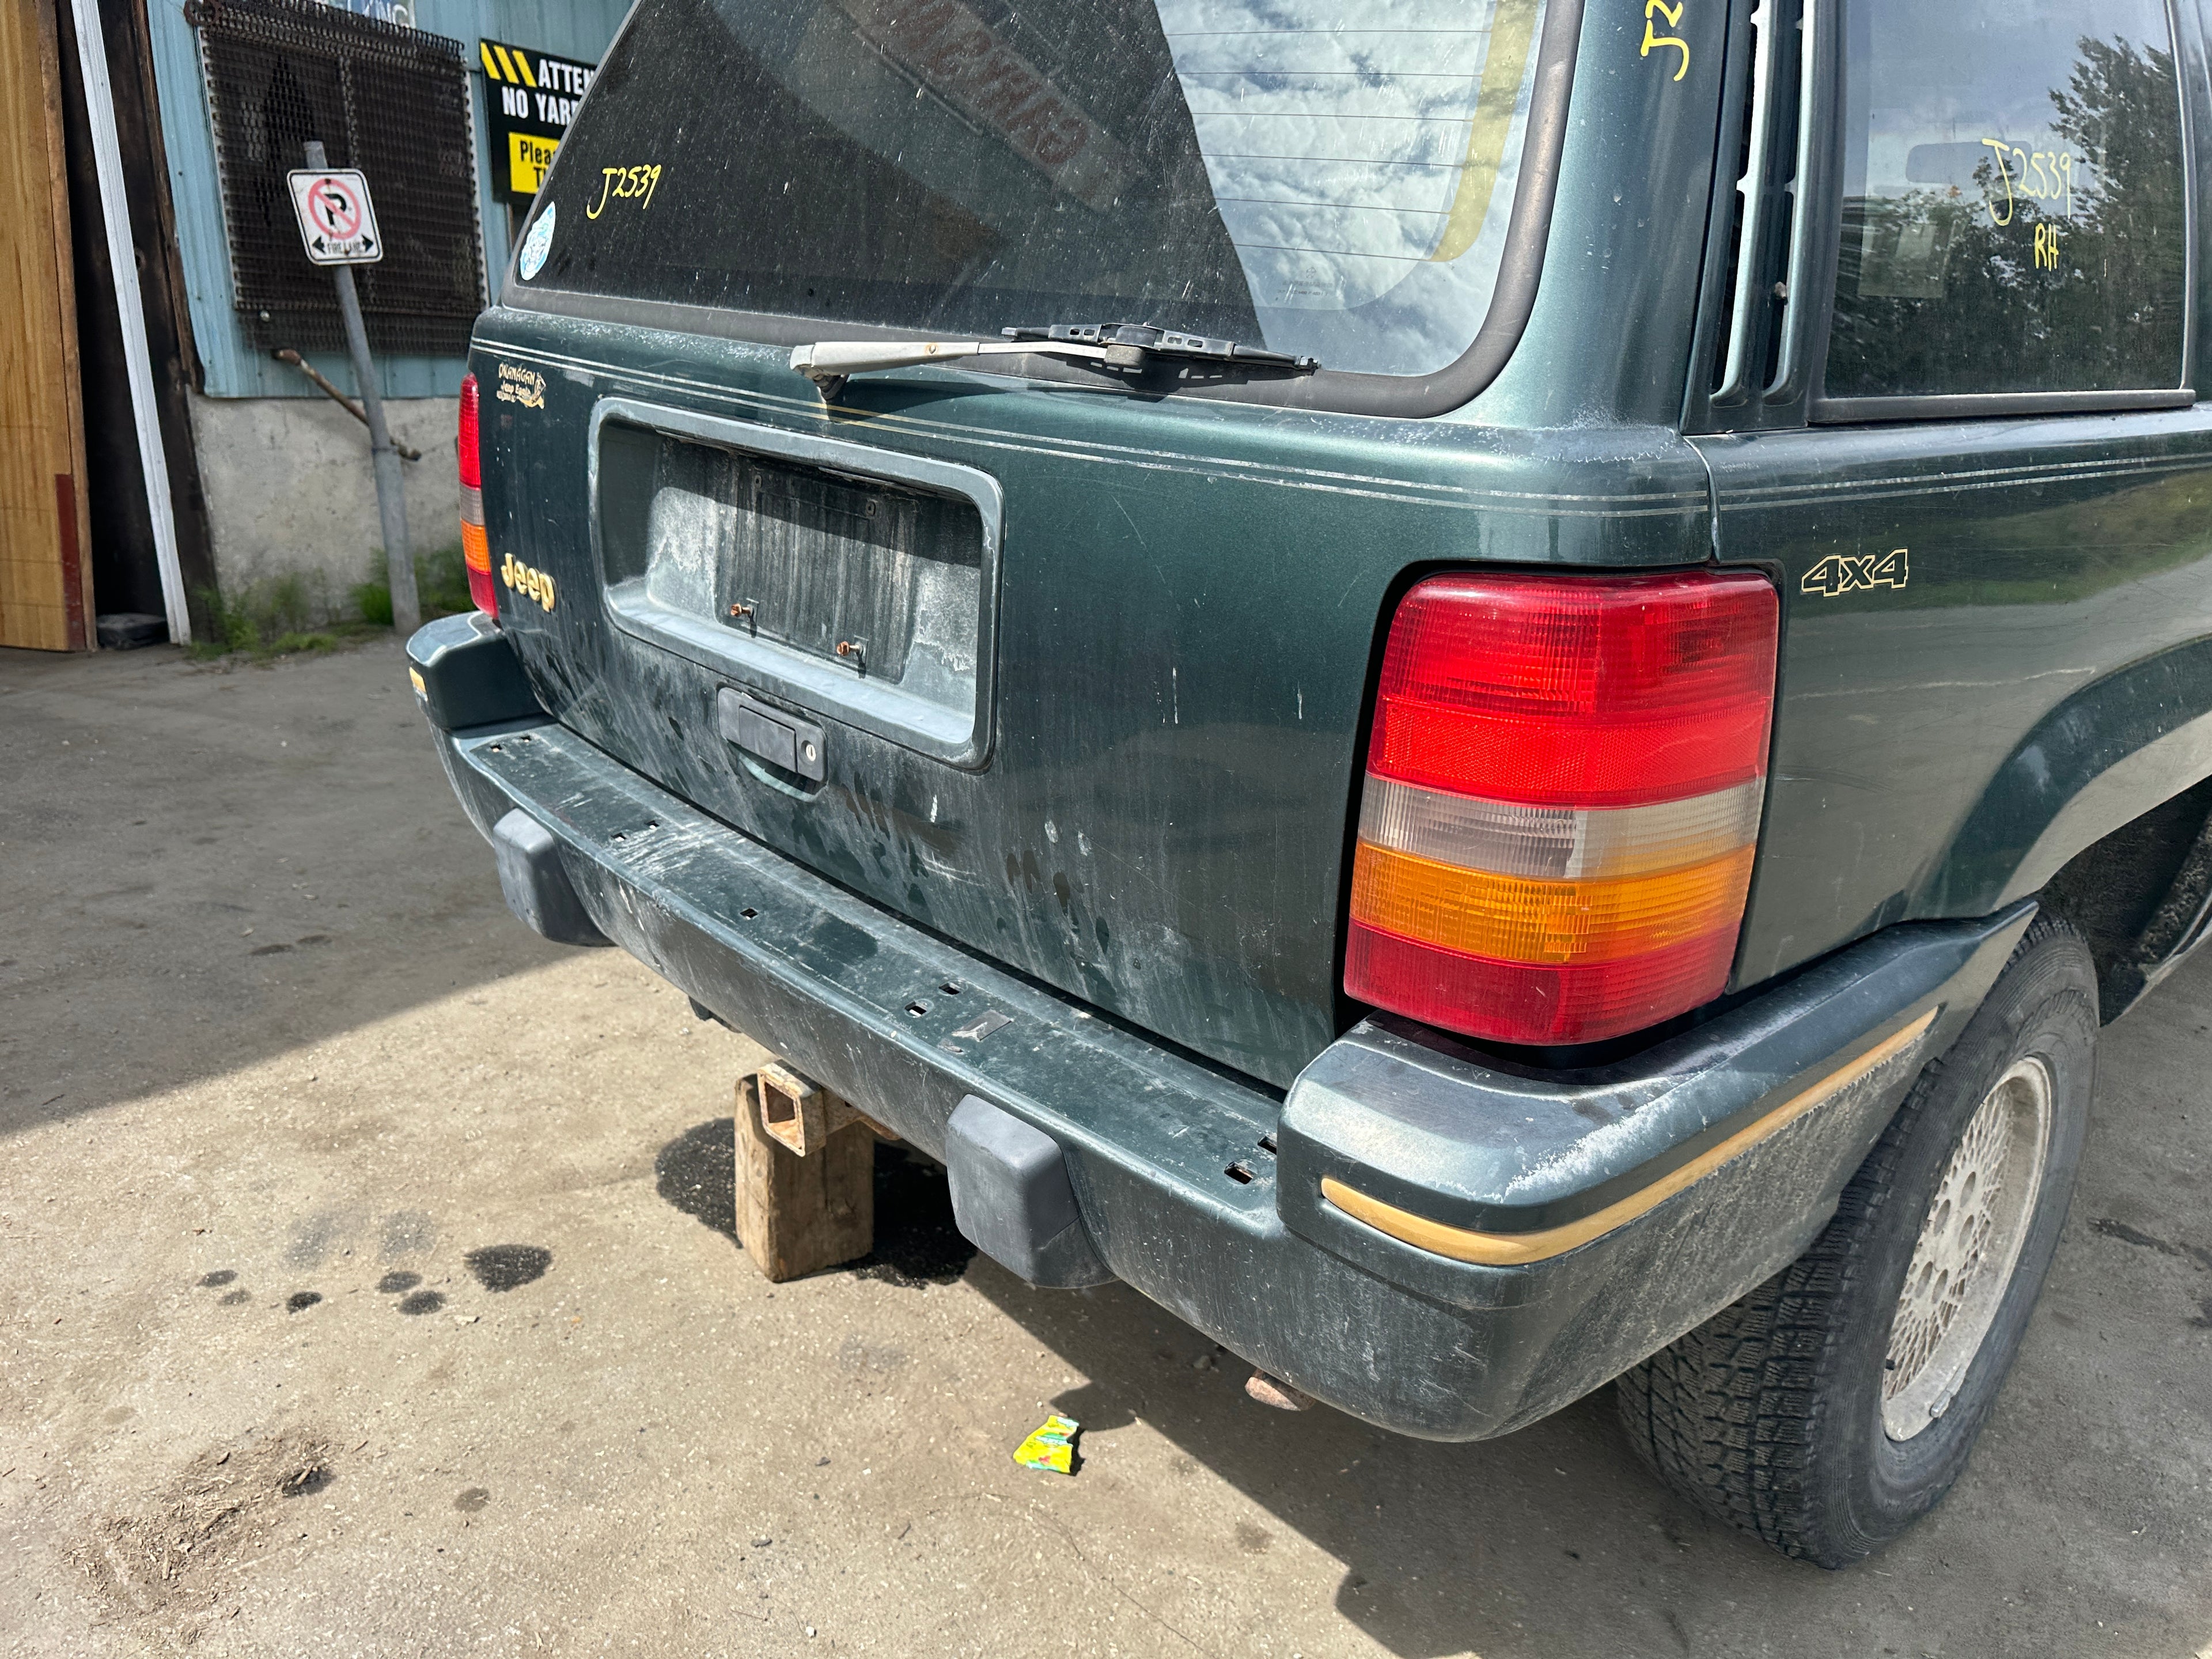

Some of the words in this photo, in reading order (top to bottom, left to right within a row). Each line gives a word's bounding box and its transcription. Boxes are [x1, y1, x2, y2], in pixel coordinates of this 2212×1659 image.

[502, 86, 529, 119] NO
[520, 140, 556, 165] Plea
[533, 166, 547, 187] T
[586, 164, 662, 219] J2539
[1982, 138, 2071, 226] J2539
[2035, 222, 2059, 272] RH
[499, 362, 535, 385] OKANAGAN
[501, 552, 555, 613] Jeep
